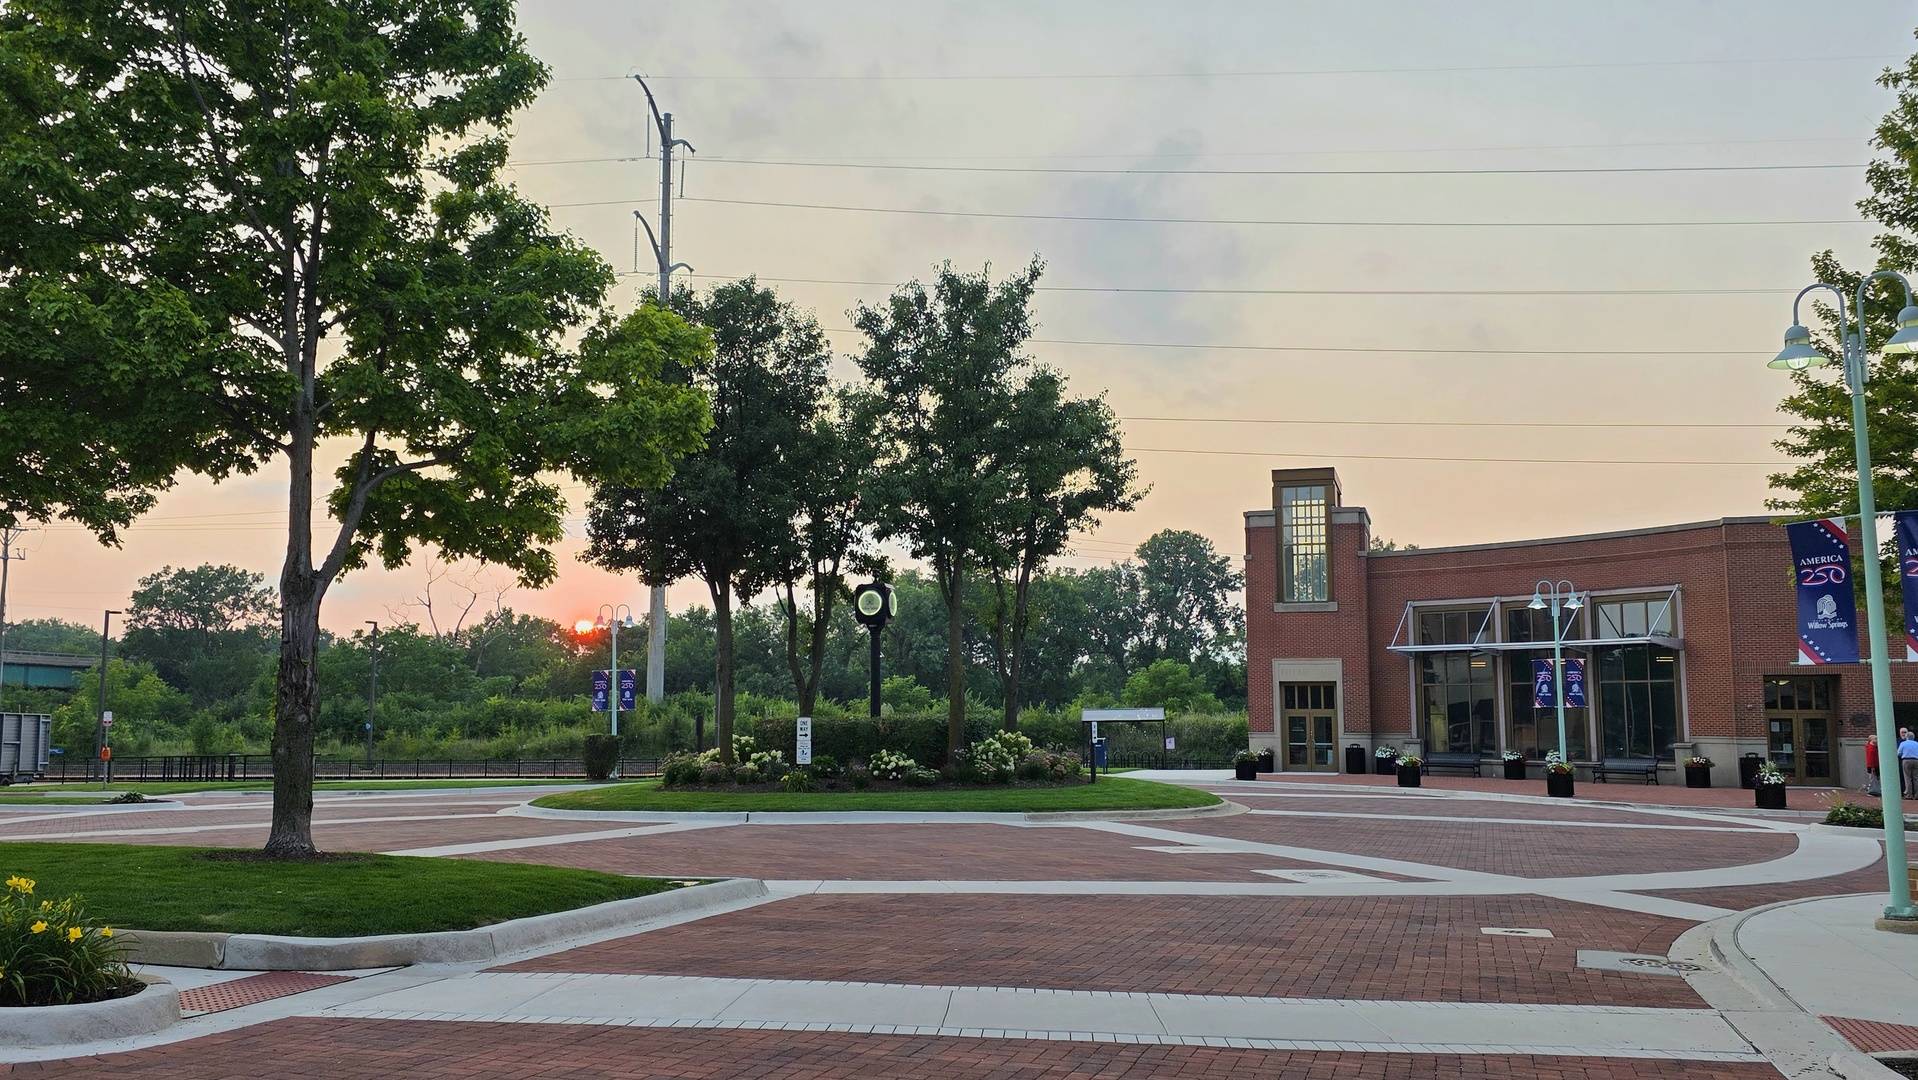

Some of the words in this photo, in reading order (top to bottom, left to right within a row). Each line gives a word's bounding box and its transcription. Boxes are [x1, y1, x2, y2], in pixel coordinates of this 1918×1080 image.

[1800, 554, 1843, 566] AMERICA
[1801, 565, 1845, 585] 250
[1808, 620, 1827, 629] Willow
[1828, 620, 1848, 629] Springs
[1536, 674, 1552, 682] 250
[1566, 674, 1582, 682] 250
